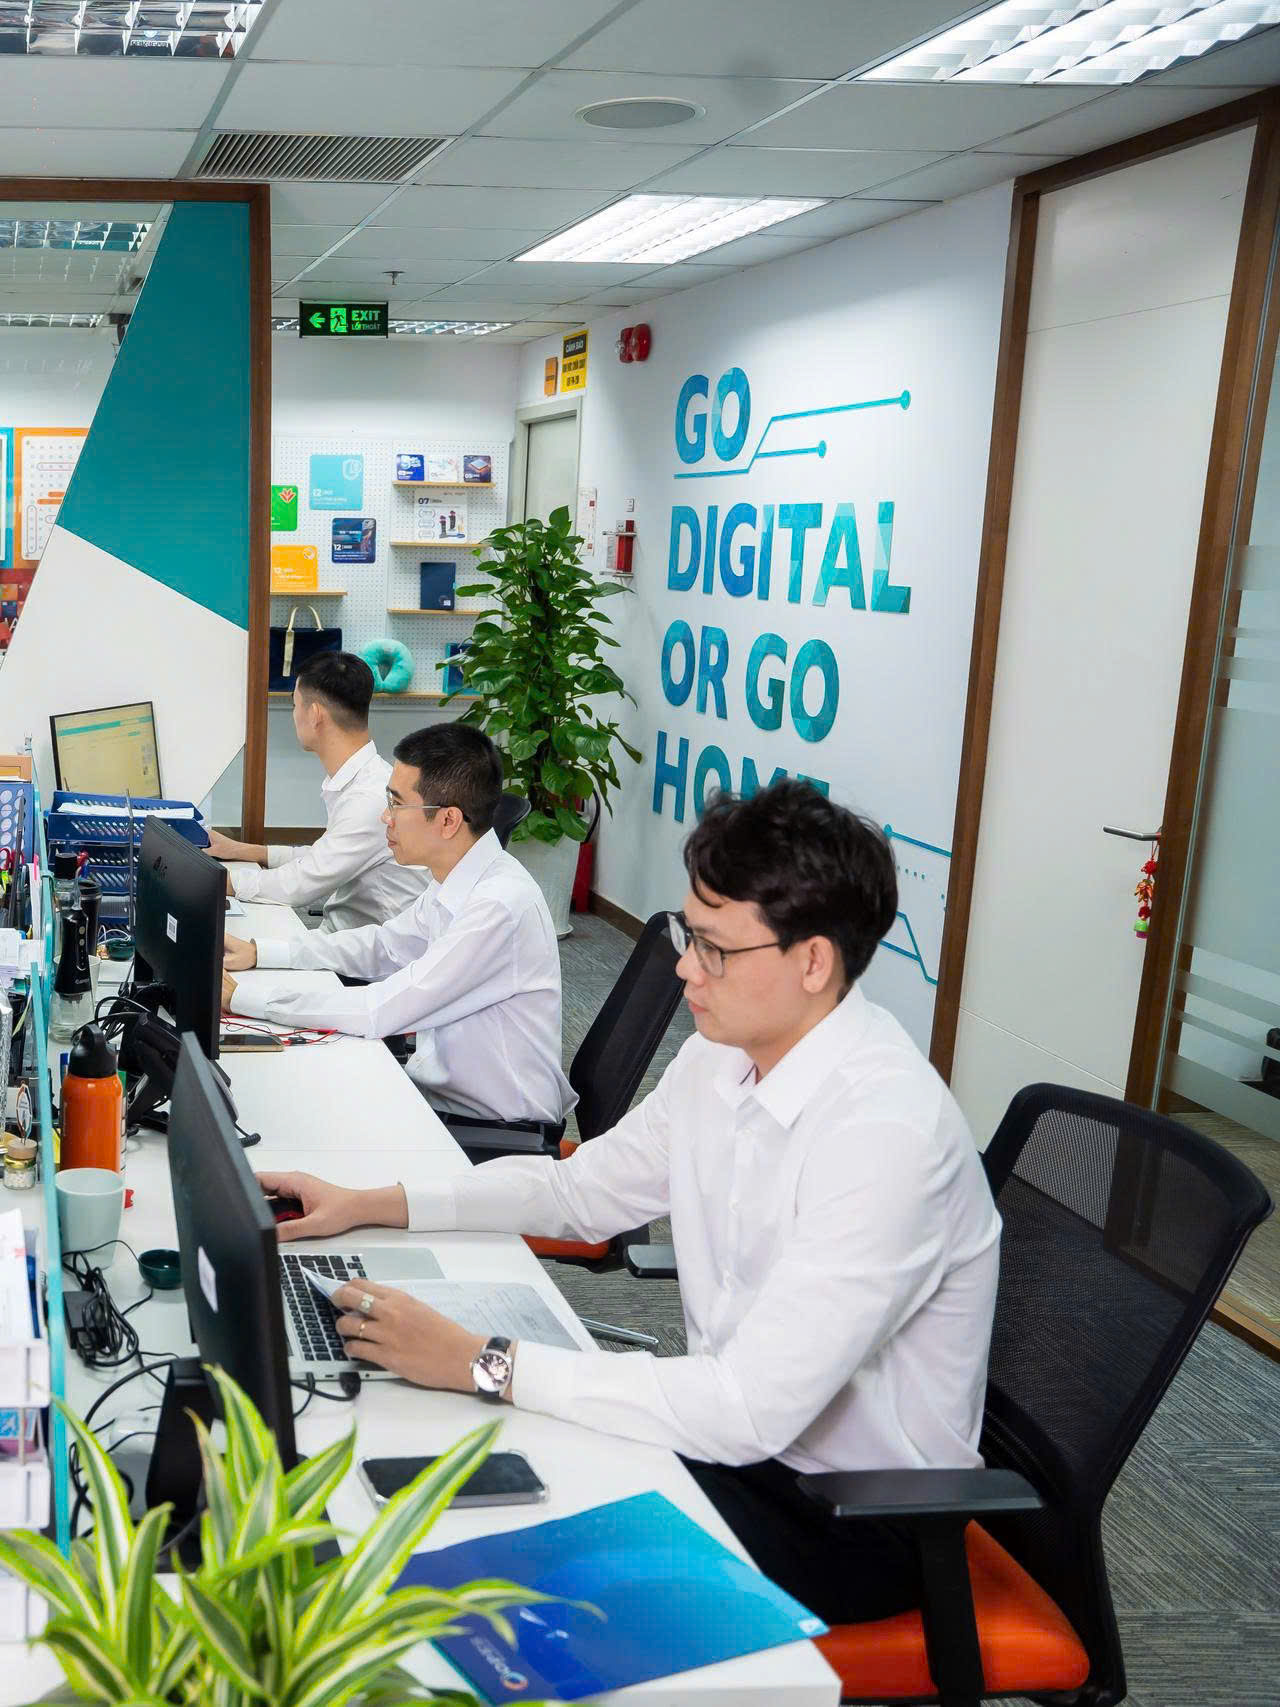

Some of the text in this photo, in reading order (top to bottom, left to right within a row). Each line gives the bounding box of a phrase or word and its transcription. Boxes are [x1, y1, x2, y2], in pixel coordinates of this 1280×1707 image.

[351, 310, 380, 321] EXIT
[675, 367, 751, 465] GO
[418, 497, 430, 505] 07
[333, 543, 342, 551] 12
[668, 501, 912, 615] DIGITAL
[661, 619, 840, 743] OR GO
